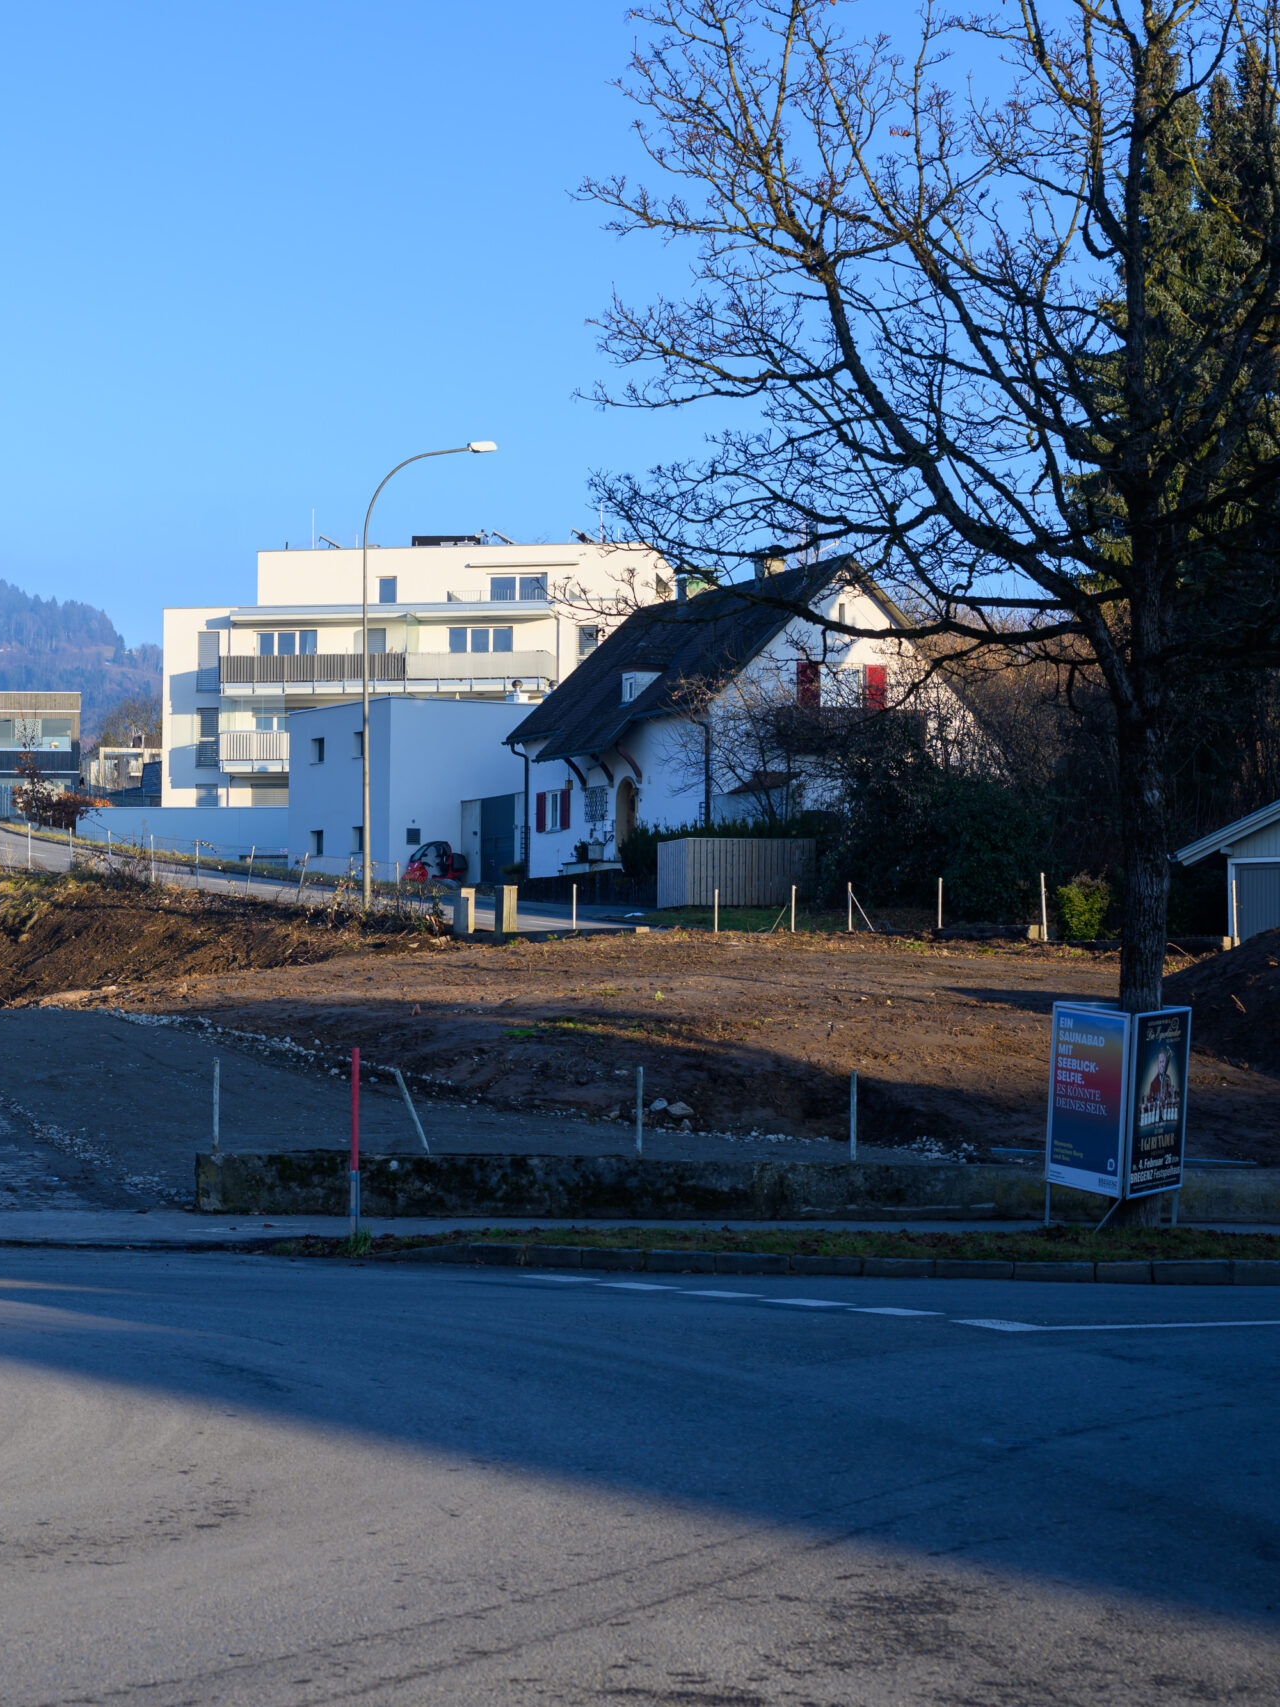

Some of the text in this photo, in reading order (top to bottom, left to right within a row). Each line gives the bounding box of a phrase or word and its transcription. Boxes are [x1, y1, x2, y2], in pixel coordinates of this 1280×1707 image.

[1060, 1016, 1073, 1029] EIN
[1059, 1030, 1105, 1047] SAUNABAD
[1058, 1043, 1073, 1056] MIT
[1057, 1056, 1099, 1073] SEEBLICK-
[1057, 1070, 1085, 1085] SELFIE.
[1056, 1083, 1101, 1101] ES KÖNNTE
[1056, 1096, 1108, 1116] DEINES SEIN.
